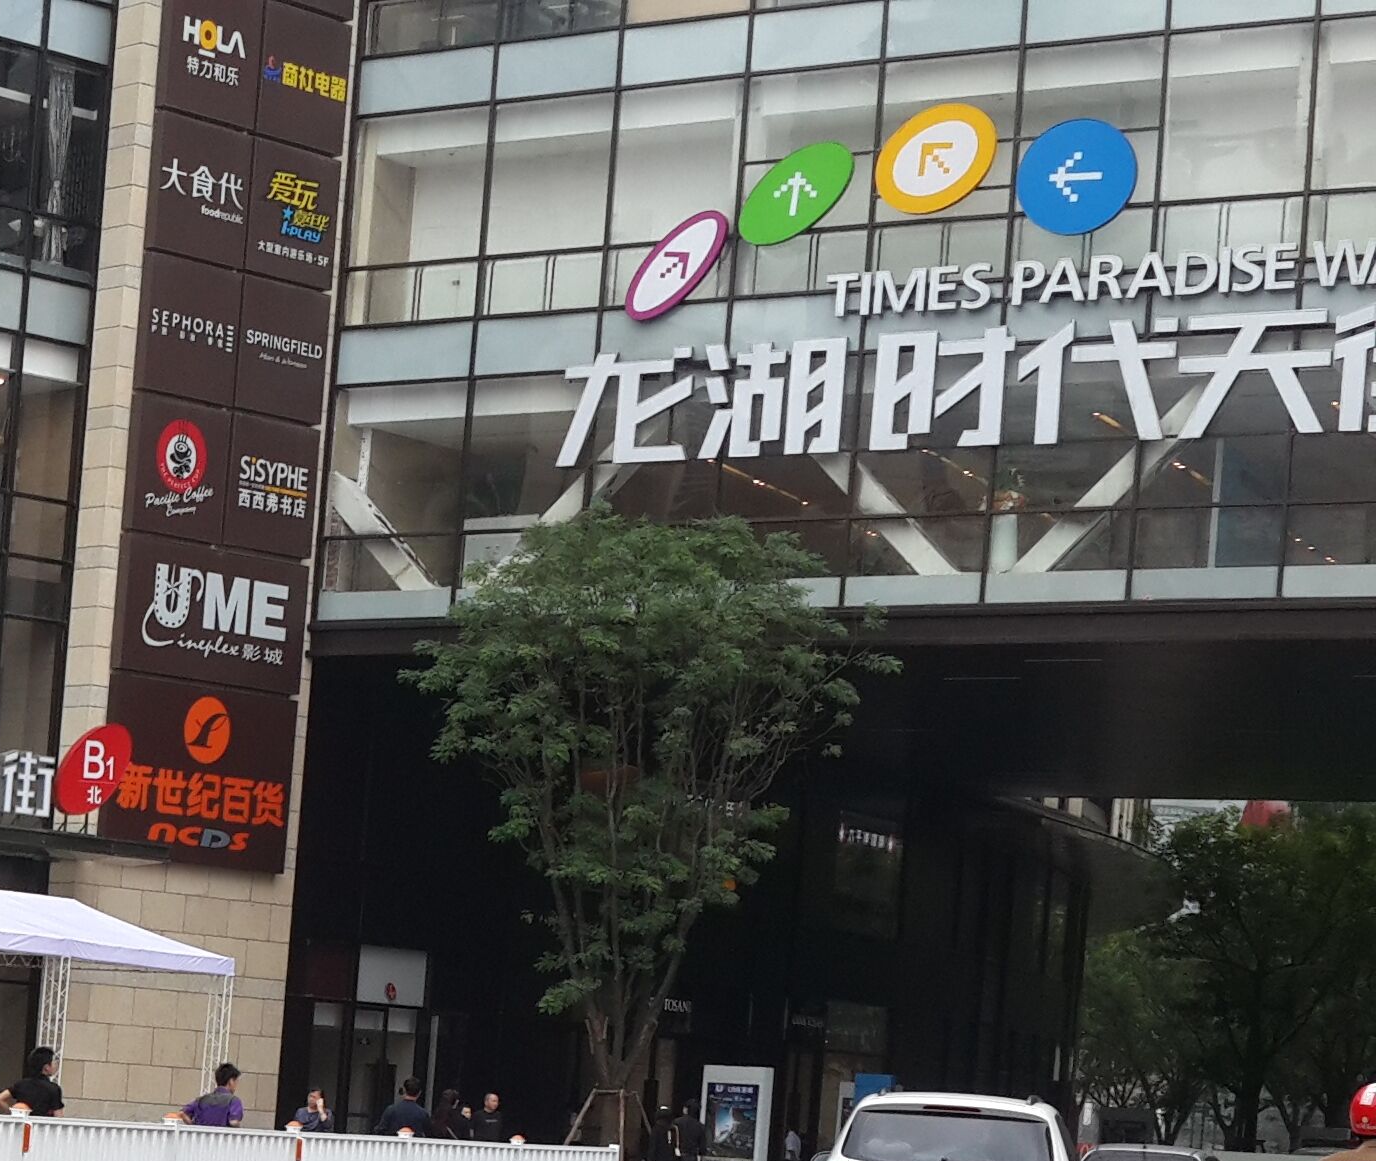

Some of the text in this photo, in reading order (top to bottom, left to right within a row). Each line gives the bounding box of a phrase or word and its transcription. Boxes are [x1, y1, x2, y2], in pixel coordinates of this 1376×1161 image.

[183, 15, 246, 59] HOLA
[186, 55, 239, 87] 特力和乐
[282, 62, 347, 102] 商社电器
[160, 158, 244, 210] 大食代
[266, 171, 321, 211] 爱玩
[826, 239, 1376, 317] TIMES PARADISE W
[151, 308, 224, 338] SEPHORA
[246, 329, 323, 360] SPRINGFIELD
[145, 485, 214, 508] Pacific Coffee
[238, 487, 307, 519] 西西弗书店
[154, 562, 290, 642] UME
[241, 642, 284, 666] 影城
[82, 739, 115, 781] B1
[86, 785, 103, 805] 北
[115, 760, 285, 828] 新世纪百货
